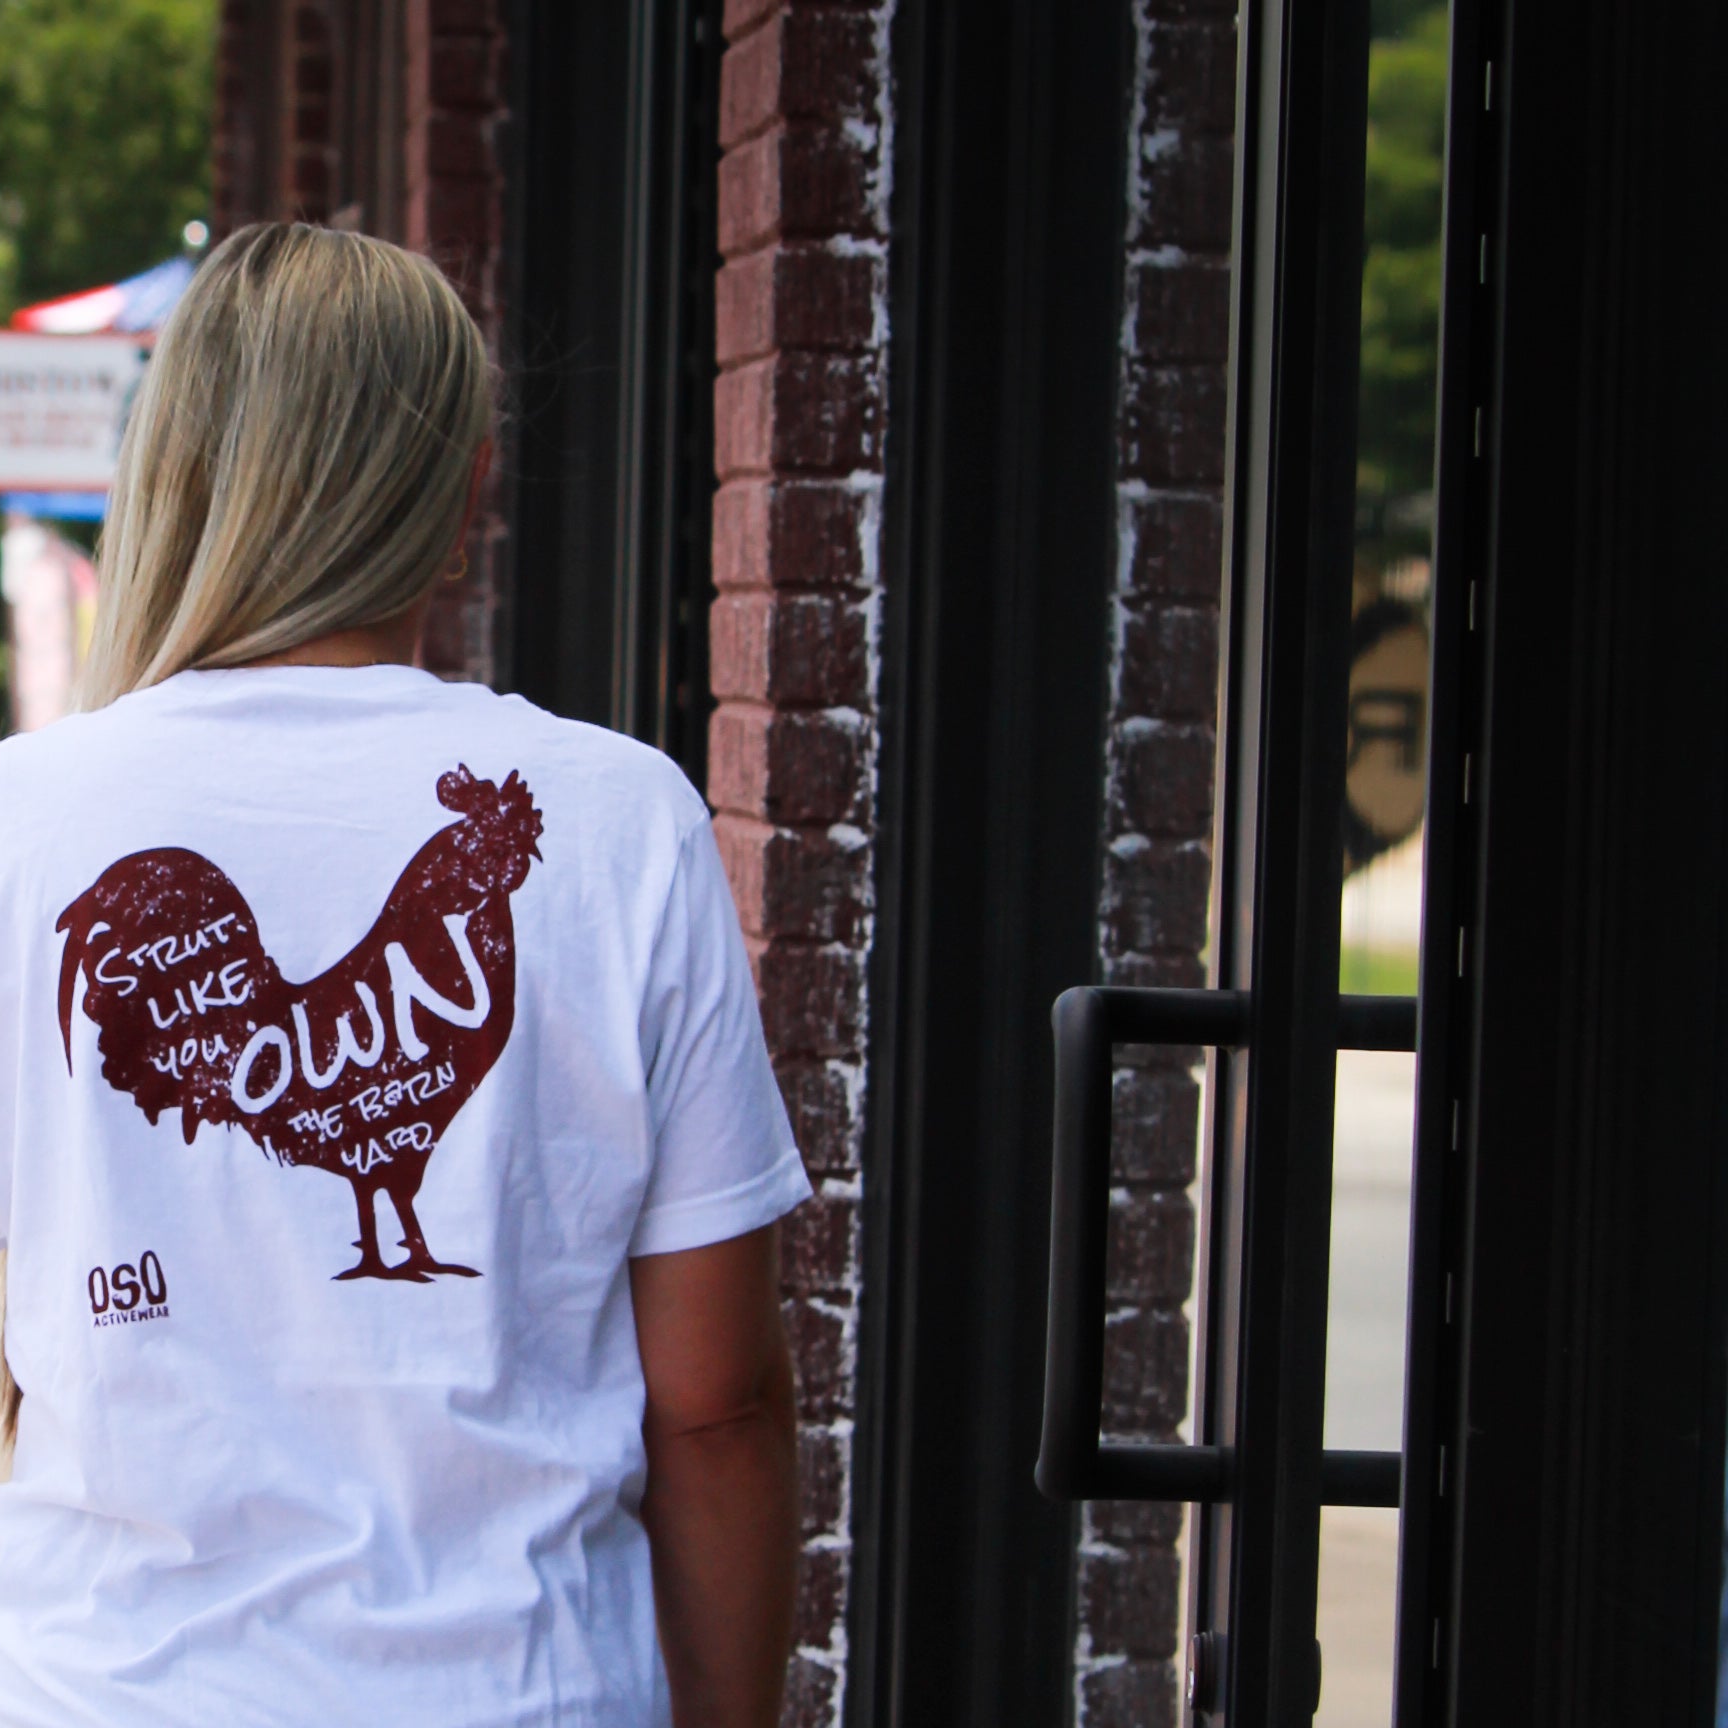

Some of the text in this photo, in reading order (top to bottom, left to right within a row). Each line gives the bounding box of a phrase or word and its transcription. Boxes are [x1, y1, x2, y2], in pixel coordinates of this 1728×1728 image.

[94, 912, 236, 996] STRUT
[147, 958, 250, 1029] LIKE
[230, 912, 491, 1114] OWN
[287, 1103, 344, 1143] THE
[340, 1121, 433, 1175] YARD
[88, 1249, 167, 1314] OSO
[93, 1305, 170, 1329] ACTIVEWEAR
